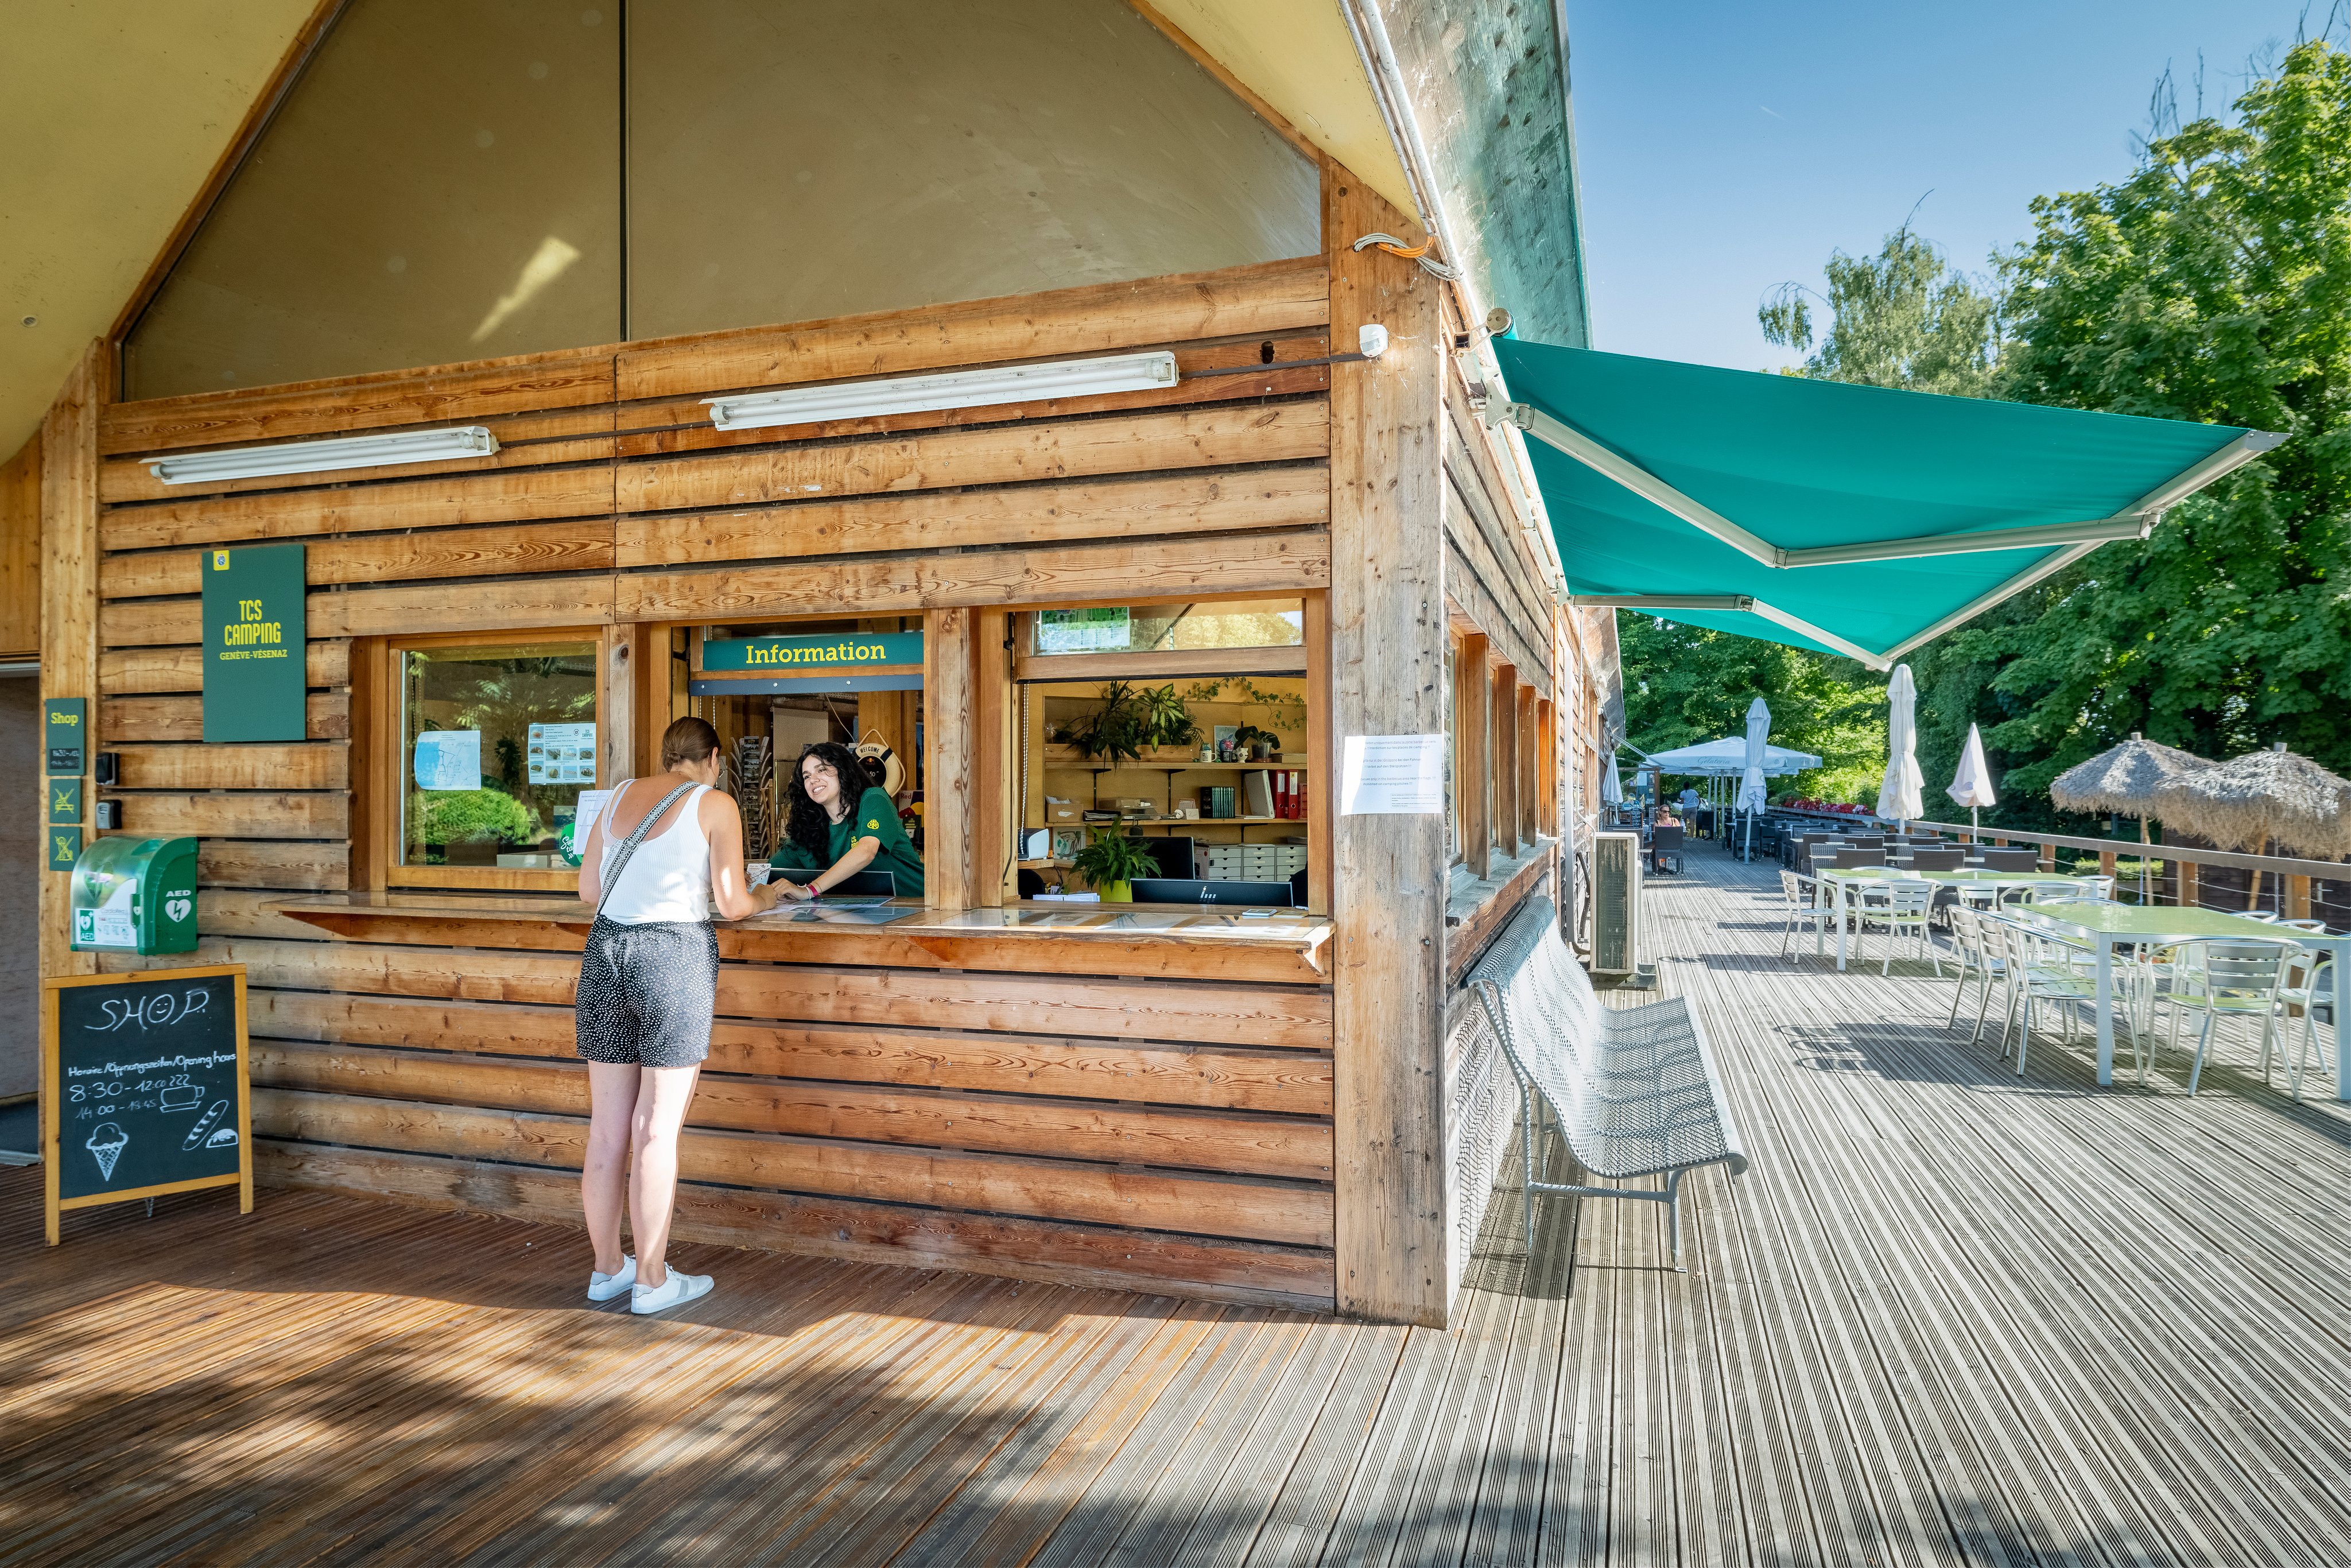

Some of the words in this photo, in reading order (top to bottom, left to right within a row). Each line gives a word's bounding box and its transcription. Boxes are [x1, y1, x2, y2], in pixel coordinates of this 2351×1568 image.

[239, 599, 262, 621] TCS
[224, 622, 281, 646] CAMPING
[220, 649, 288, 660] GENÈVE-VÉSENAZ
[746, 642, 886, 663] Information
[51, 712, 79, 727] Shop
[1697, 756, 1731, 766] Gelateria
[561, 836, 574, 850] Swi
[84, 991, 210, 1031] SHOP
[69, 1082, 123, 1102] 8:30
[134, 1080, 167, 1092] 12:00
